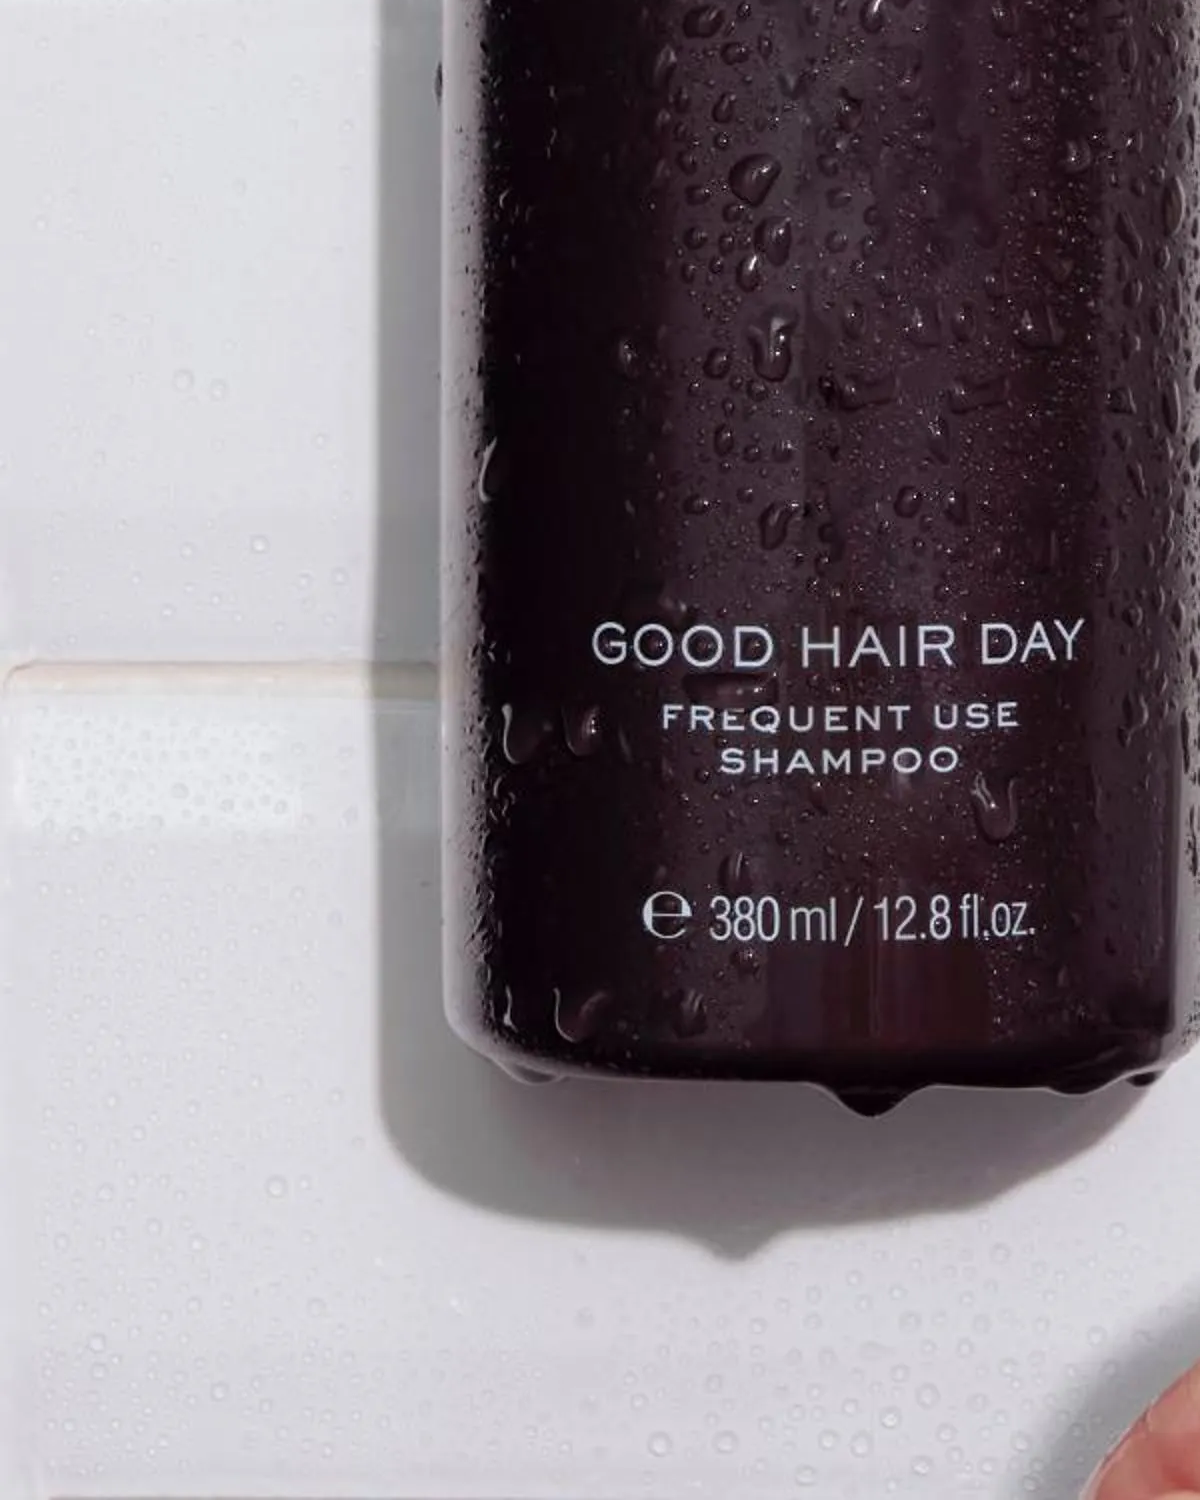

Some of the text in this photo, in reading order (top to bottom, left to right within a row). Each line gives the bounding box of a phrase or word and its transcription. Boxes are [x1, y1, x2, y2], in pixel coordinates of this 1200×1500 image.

[592, 617, 1085, 669] GOOD HAIR DAY
[661, 701, 1019, 734] FREQUENT USE
[719, 747, 959, 775] SHAMPOO
[710, 895, 780, 942] 380
[873, 893, 951, 941] 12.8
